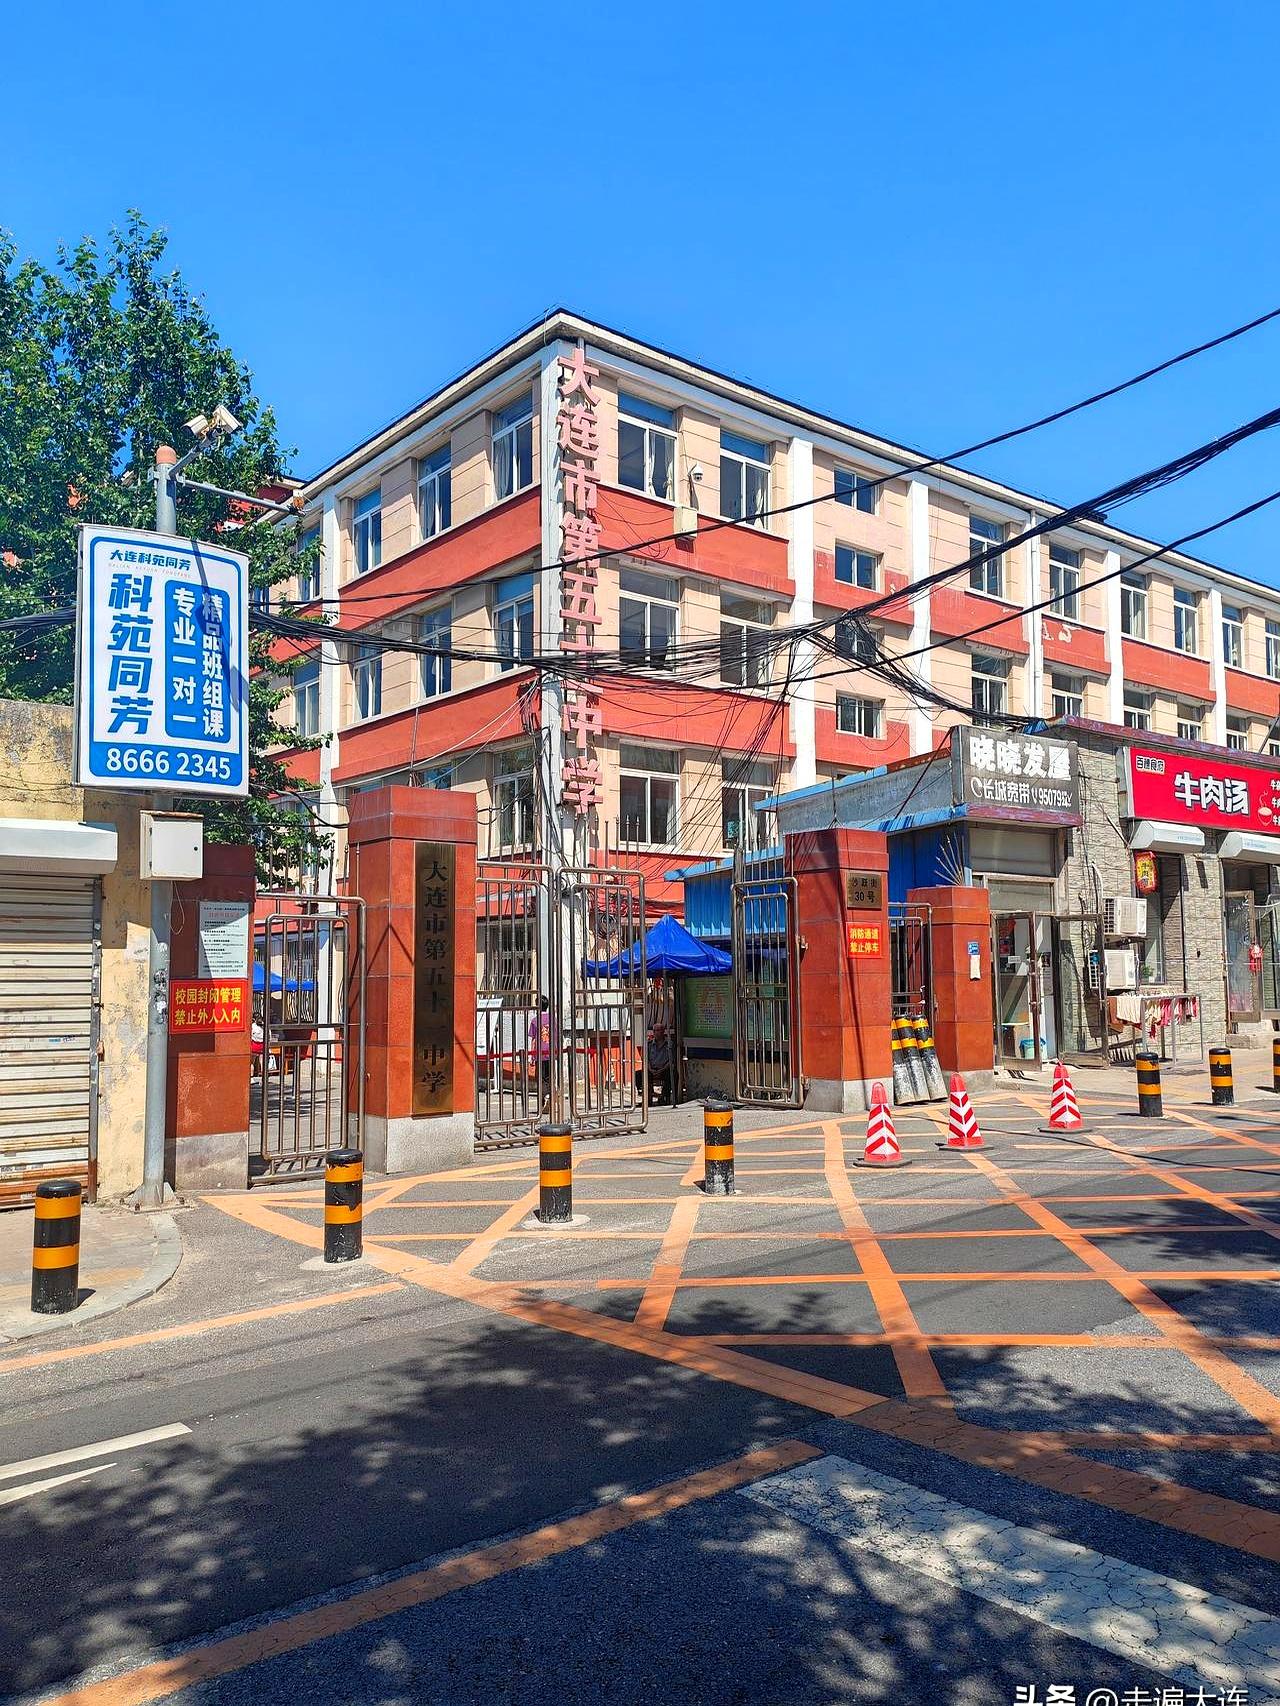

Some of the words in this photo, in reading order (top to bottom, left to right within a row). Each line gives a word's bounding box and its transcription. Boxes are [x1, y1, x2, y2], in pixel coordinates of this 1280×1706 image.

[110, 549, 191, 571] 大连科苑同芳
[107, 573, 154, 735] 科苑同芳
[172, 587, 196, 723] 专业一对一
[202, 591, 224, 738] 精品班组课
[106, 748, 170, 775] 8666
[176, 752, 231, 779] 2345
[983, 778, 1030, 803] 长城宽带
[1174, 771, 1249, 815] 牛肉汤
[854, 891, 876, 903] 30号
[849, 928, 879, 940] 消防通道
[849, 942, 879, 953] 禁止停车
[423, 861, 448, 1094] 大连市第五十一中学
[175, 987, 242, 1005] 校园封闭管理
[174, 1007, 241, 1026] 禁止外人入内
